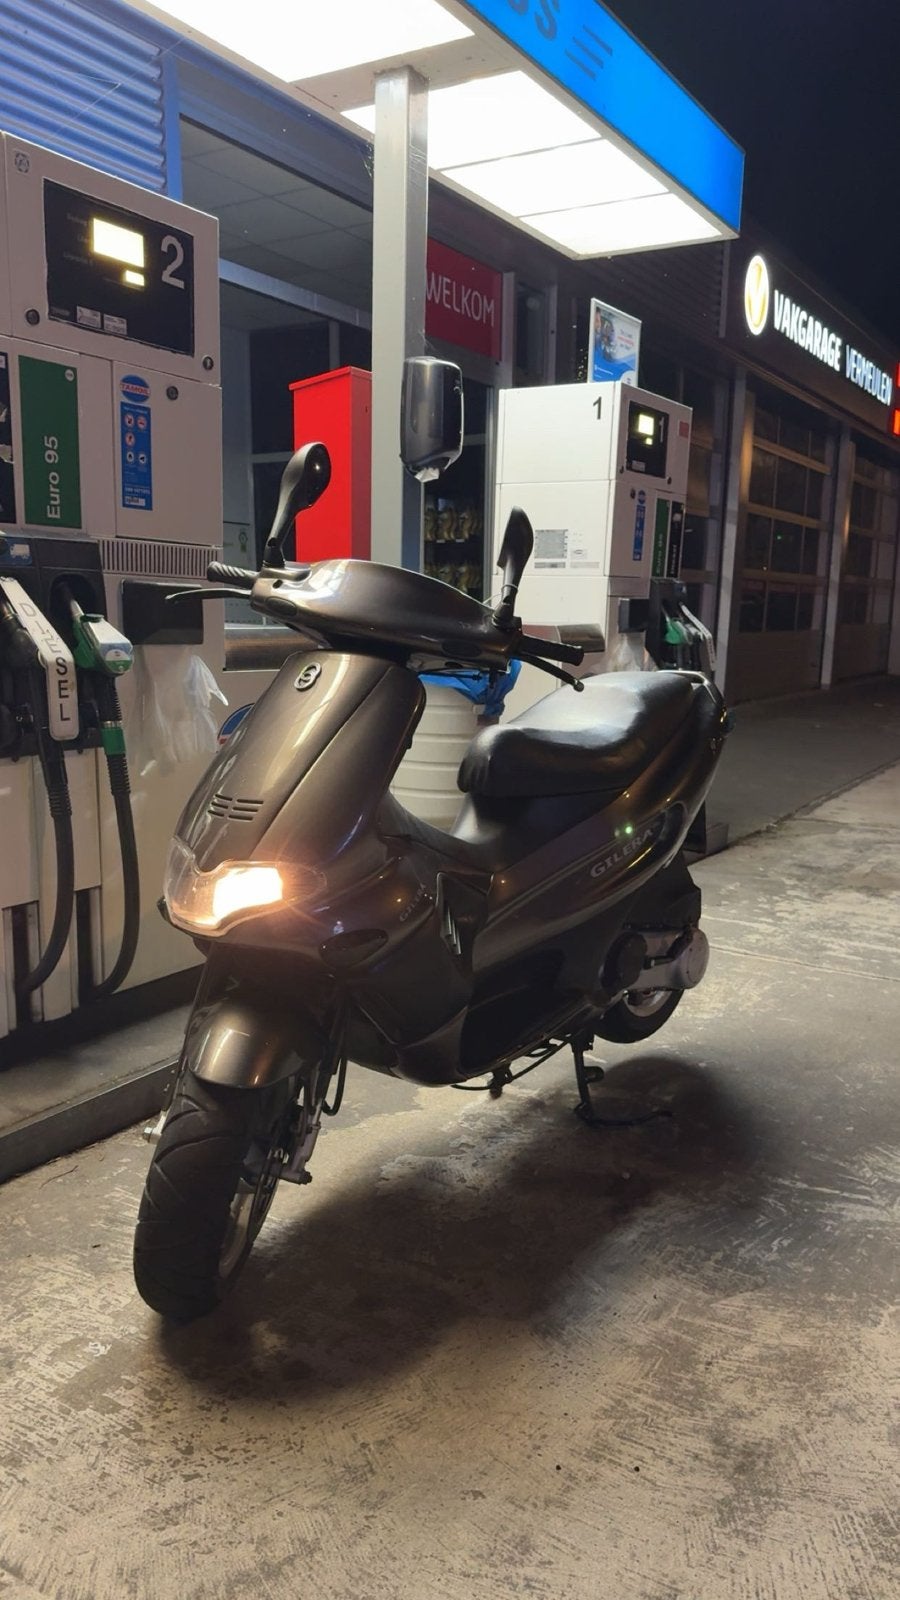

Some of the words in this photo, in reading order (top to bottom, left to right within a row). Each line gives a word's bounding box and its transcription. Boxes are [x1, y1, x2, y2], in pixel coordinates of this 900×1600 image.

[161, 235, 185, 289] 2
[426, 271, 495, 328] WELKOM
[774, 289, 842, 372] VAKGARAGE
[845, 344, 893, 407] VERMEULEN
[593, 396, 602, 420] 1
[659, 416, 665, 443] 1
[44, 435, 59, 464] 95
[46, 472, 61, 519] Euro
[20, 603, 71, 721] DIESEL
[590, 829, 653, 878] GILERA
